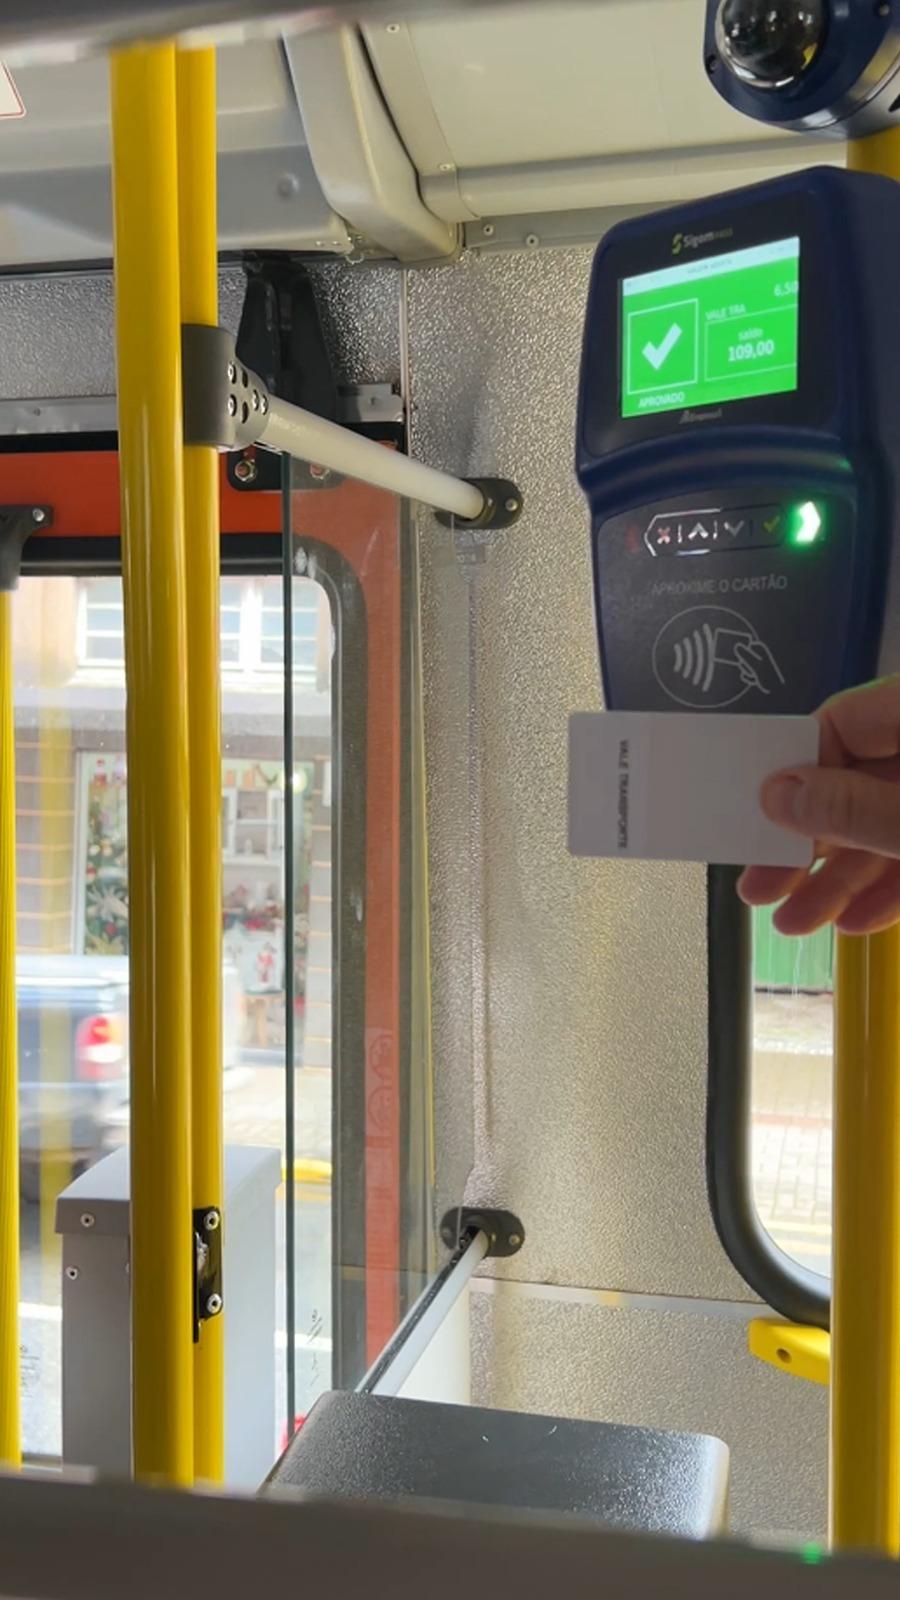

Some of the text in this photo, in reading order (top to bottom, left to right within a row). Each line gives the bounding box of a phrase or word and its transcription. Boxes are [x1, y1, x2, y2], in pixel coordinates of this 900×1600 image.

[728, 340, 774, 362] 109,00
[718, 578, 729, 593] O
[731, 573, 788, 592] CARTÃO
[618, 740, 629, 769] VALE
